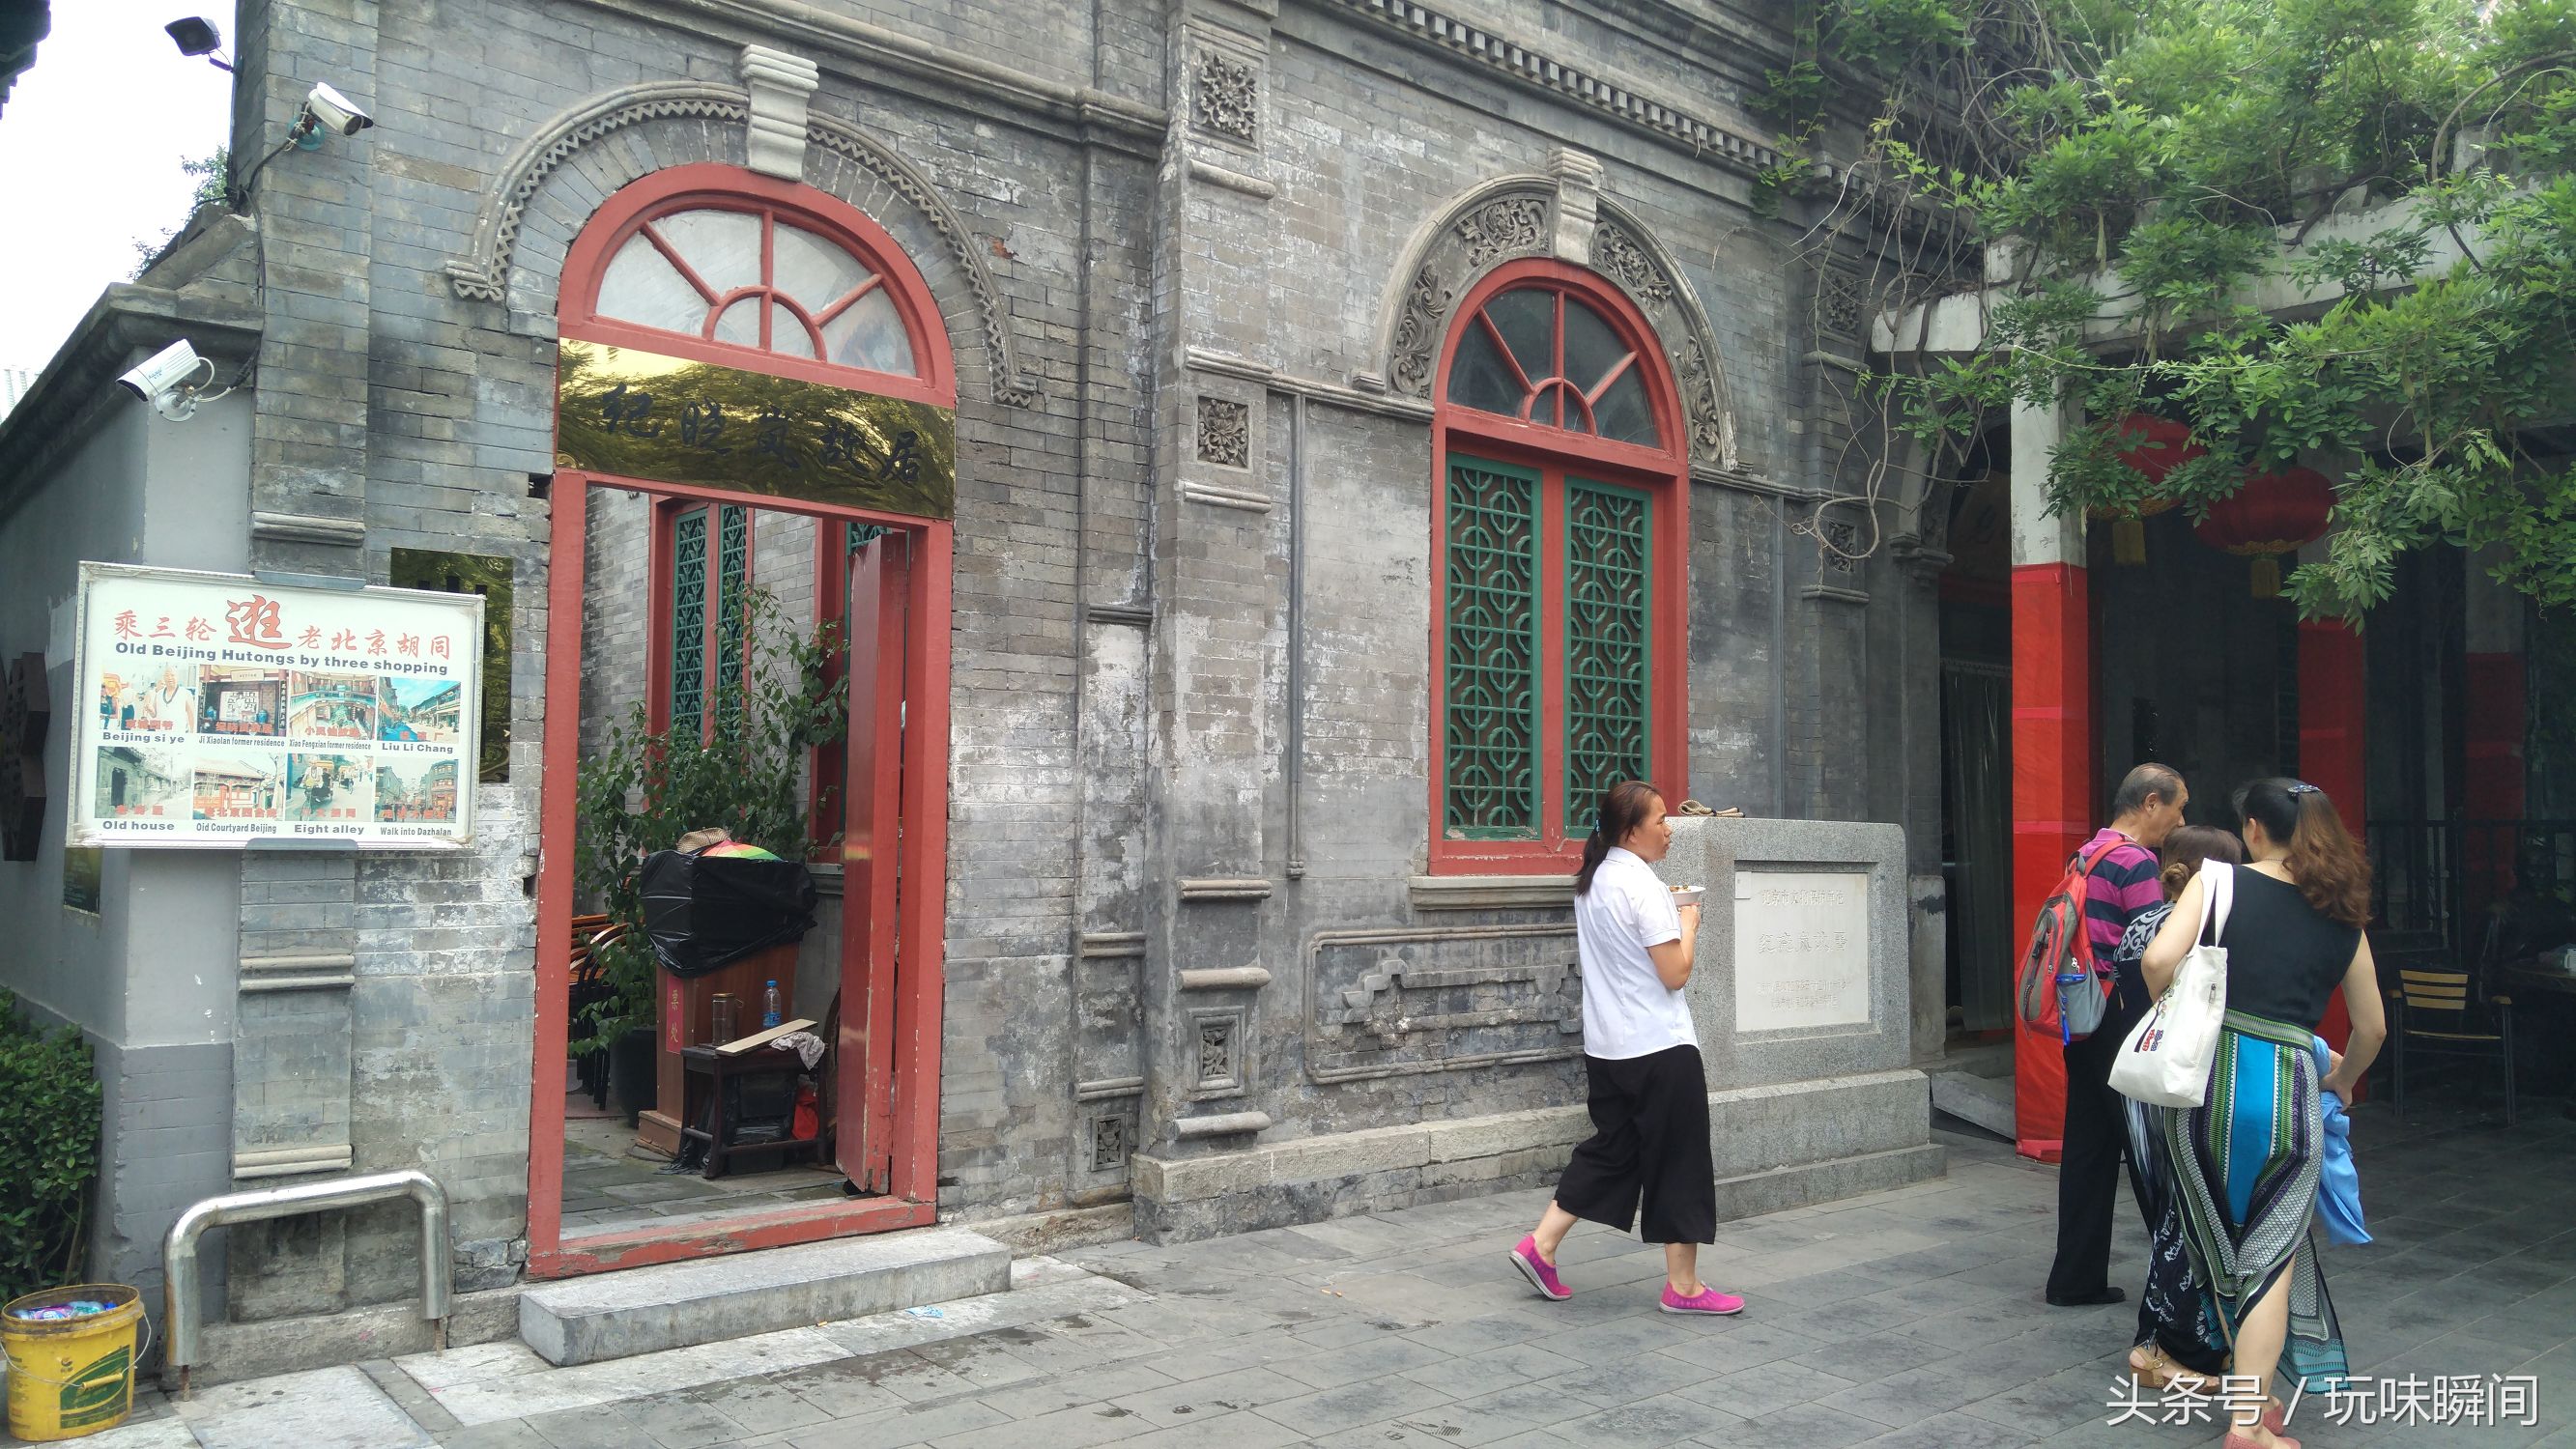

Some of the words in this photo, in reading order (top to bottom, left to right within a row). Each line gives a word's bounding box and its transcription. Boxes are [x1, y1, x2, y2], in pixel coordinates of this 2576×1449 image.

[115, 642, 147, 655] Old
[152, 644, 216, 661] Beijing
[221, 649, 296, 666] Hutongs
[300, 654, 320, 668] by
[325, 656, 369, 668] three
[373, 660, 448, 675] shopping
[102, 731, 151, 743] Beijing
[154, 733, 166, 743] si
[169, 735, 186, 744] ye
[199, 736, 206, 745] Ji
[206, 736, 231, 745] Xiaolan
[232, 737, 253, 746] former
[254, 738, 285, 747] residence
[289, 739, 301, 748] Xiao
[301, 739, 327, 749] Fengxian
[327, 740, 345, 749] former
[345, 741, 372, 750] residence
[382, 742, 400, 751] Liu
[403, 743, 414, 752] Li
[416, 744, 454, 754] Chang
[102, 820, 128, 830] Old
[130, 821, 175, 831] house
[211, 822, 249, 834] Courtyard
[250, 823, 277, 834] Beijing
[294, 824, 329, 835] Eight
[331, 825, 365, 836] alley
[380, 826, 399, 836] Walk
[400, 827, 416, 836] into
